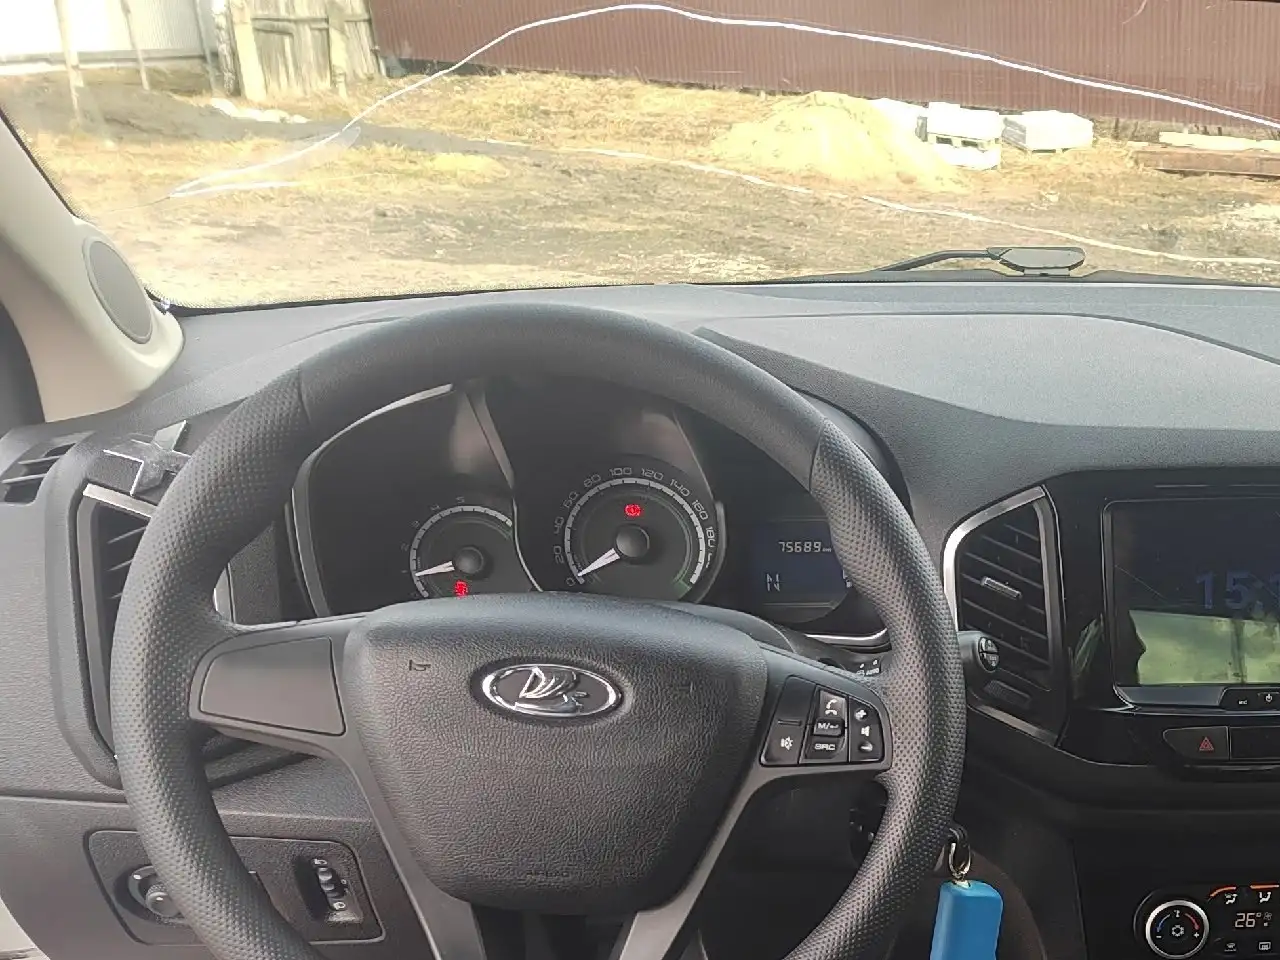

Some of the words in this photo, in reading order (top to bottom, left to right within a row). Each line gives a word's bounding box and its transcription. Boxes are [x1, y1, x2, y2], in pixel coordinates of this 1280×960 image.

[609, 467, 632, 476] 100
[641, 467, 664, 481] 120
[583, 474, 601, 488] 80
[669, 478, 691, 497] 140
[691, 499, 709, 521] 160
[554, 516, 564, 534] 40
[553, 545, 564, 564] 20
[778, 541, 822, 553] 75689
[766, 573, 781, 591] N
[814, 743, 836, 751] SRC
